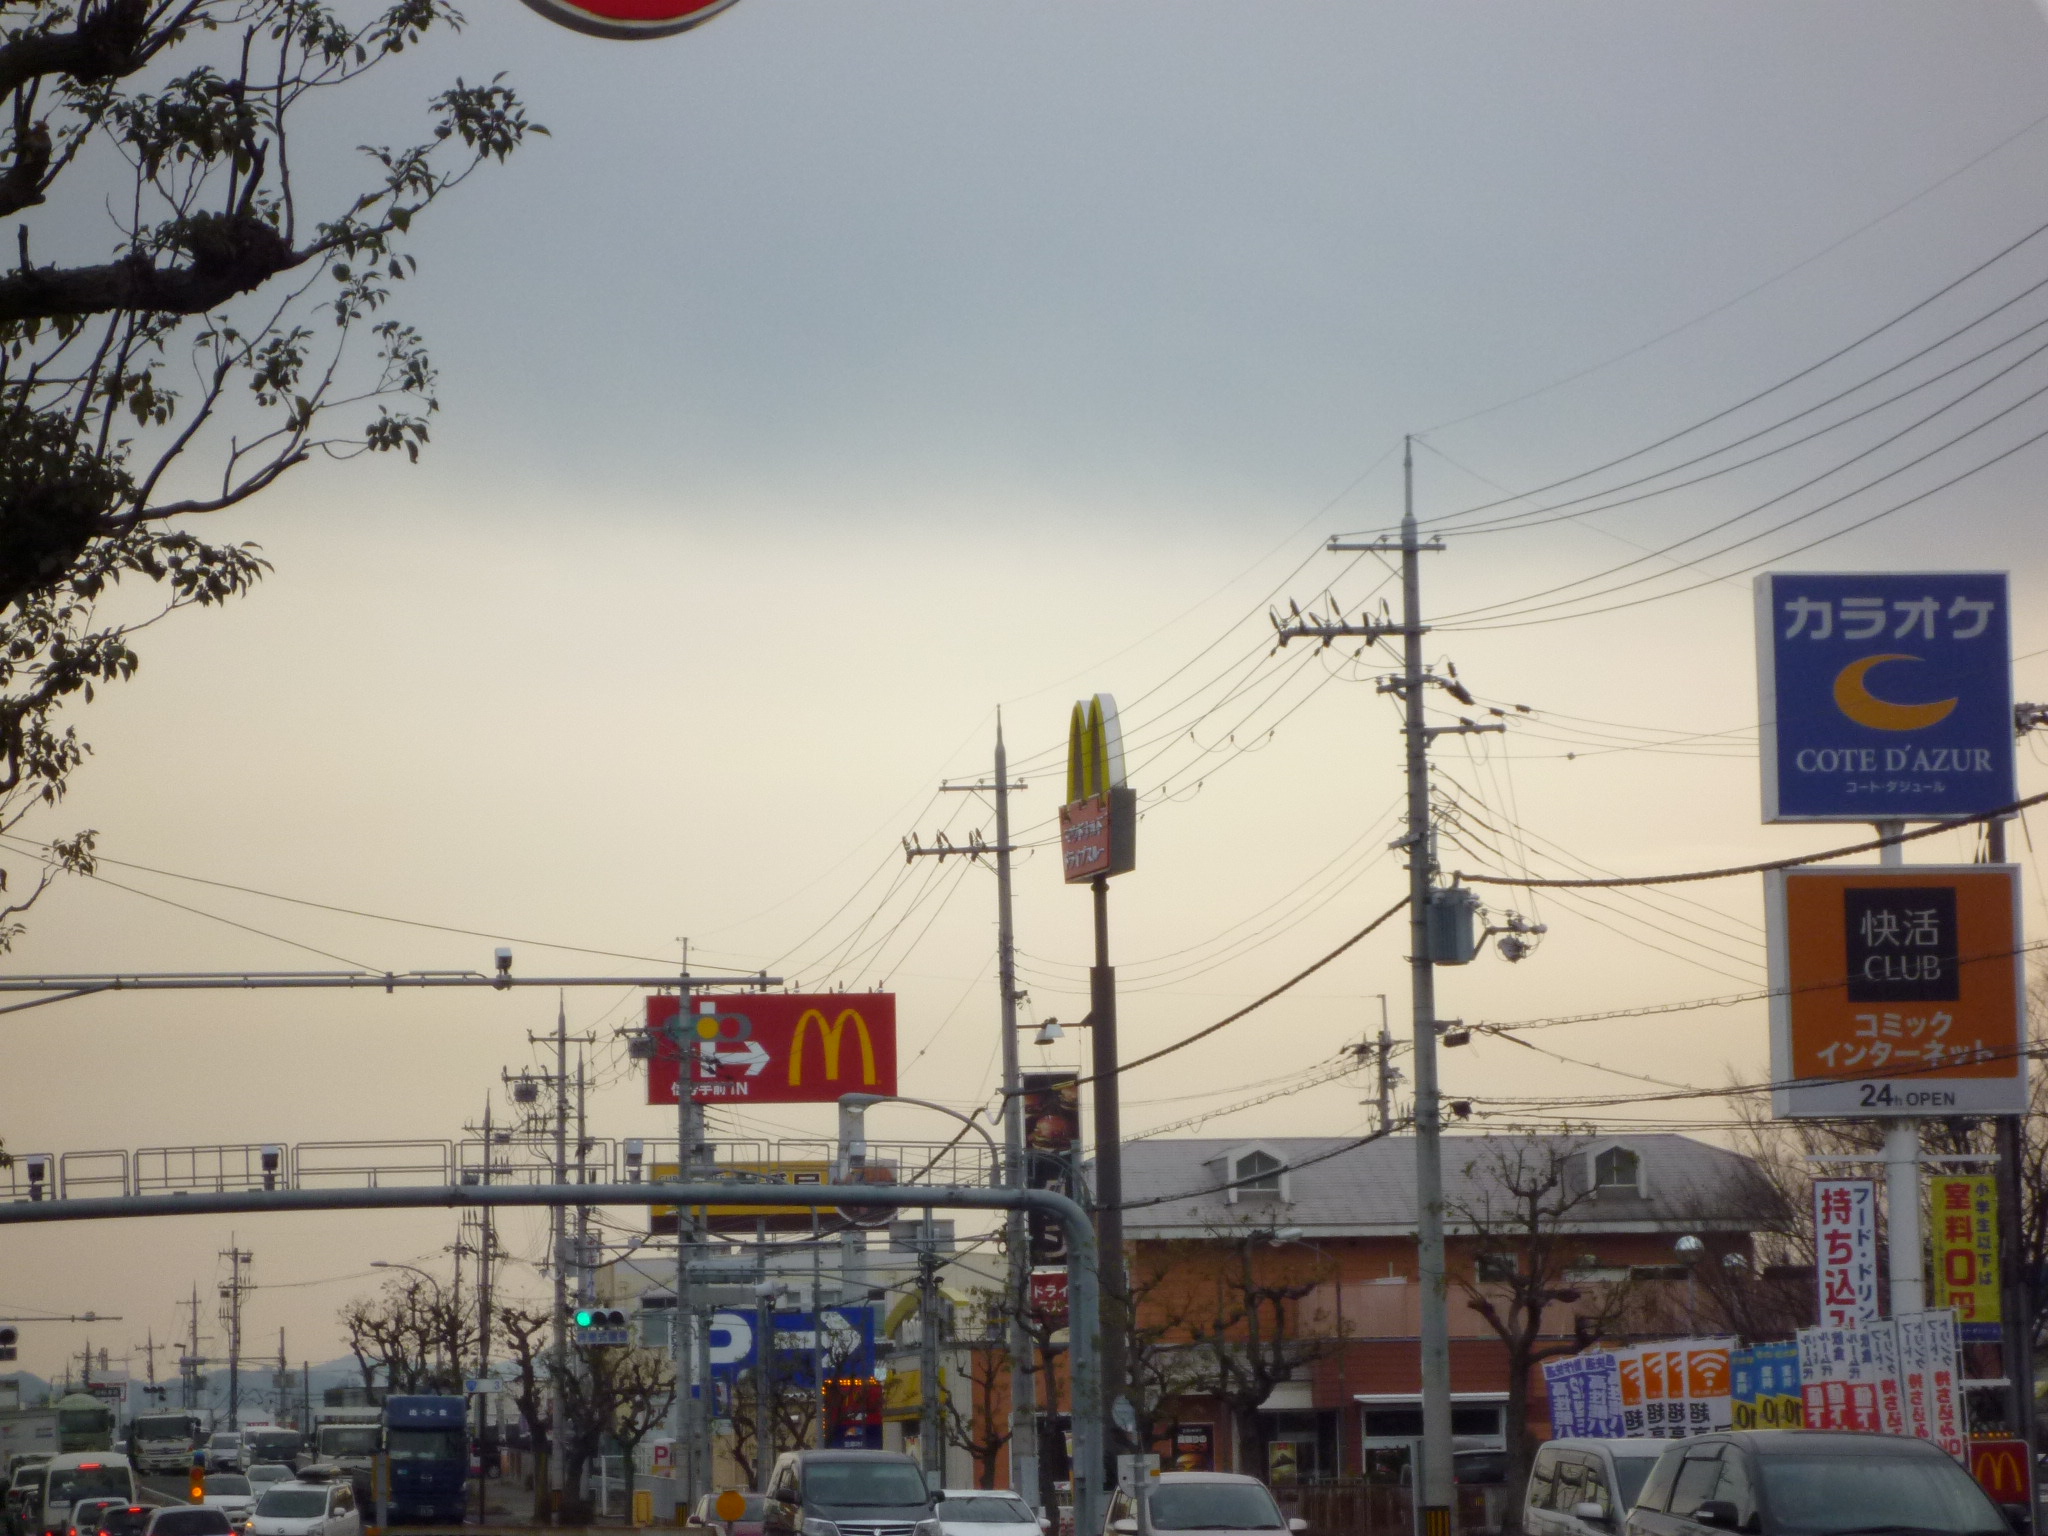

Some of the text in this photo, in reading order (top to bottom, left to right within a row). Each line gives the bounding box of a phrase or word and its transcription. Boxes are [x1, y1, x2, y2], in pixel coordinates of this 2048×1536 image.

[1784, 596, 1994, 641] カラオケ
[1796, 744, 1993, 773] COTE D'AZUR
[1846, 780, 1945, 794] コート・ダジュール
[1860, 908, 1940, 948] 快活
[1864, 955, 1941, 982] CLUB
[1855, 1010, 1953, 1038] コミック
[1817, 1039, 1995, 1068] インターネット
[1906, 1092, 1955, 1106] OPEN
[1853, 1187, 1874, 1329] フード・ドリン
